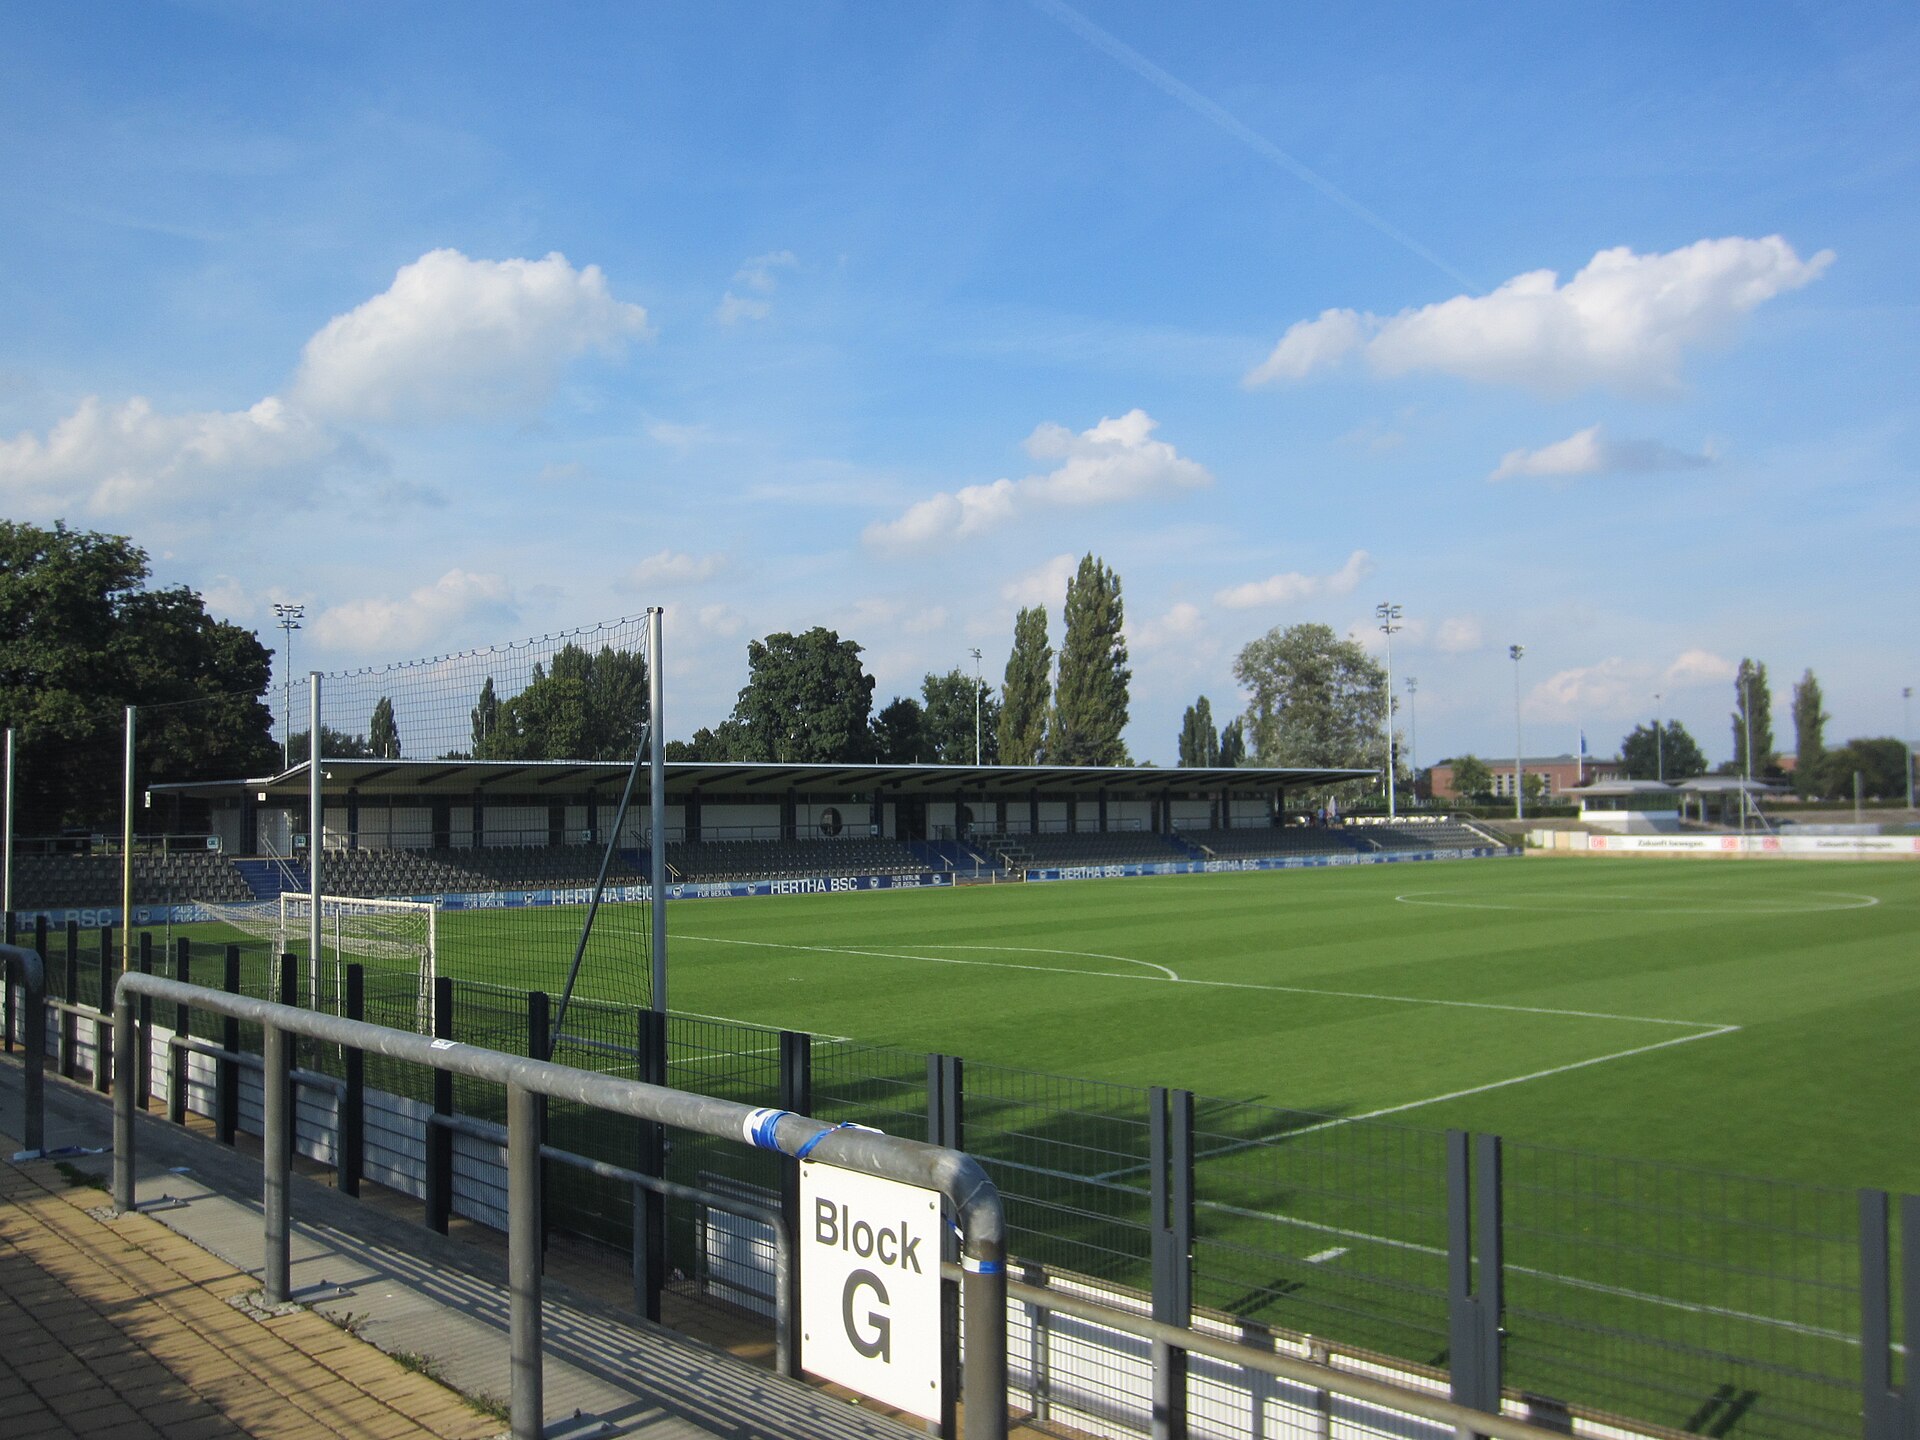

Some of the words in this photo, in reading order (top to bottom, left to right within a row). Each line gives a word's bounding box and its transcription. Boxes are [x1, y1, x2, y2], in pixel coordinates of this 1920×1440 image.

[1059, 866, 1102, 880] HERTHA
[1104, 865, 1125, 877] BSC
[1204, 860, 1240, 872] HERTHA
[1242, 859, 1260, 871] BSC
[710, 888, 732, 898] BERLIN
[770, 879, 826, 895] HERTHA
[830, 877, 858, 892] BSC
[815, 1197, 923, 1275] Block
[842, 1268, 891, 1364] G
